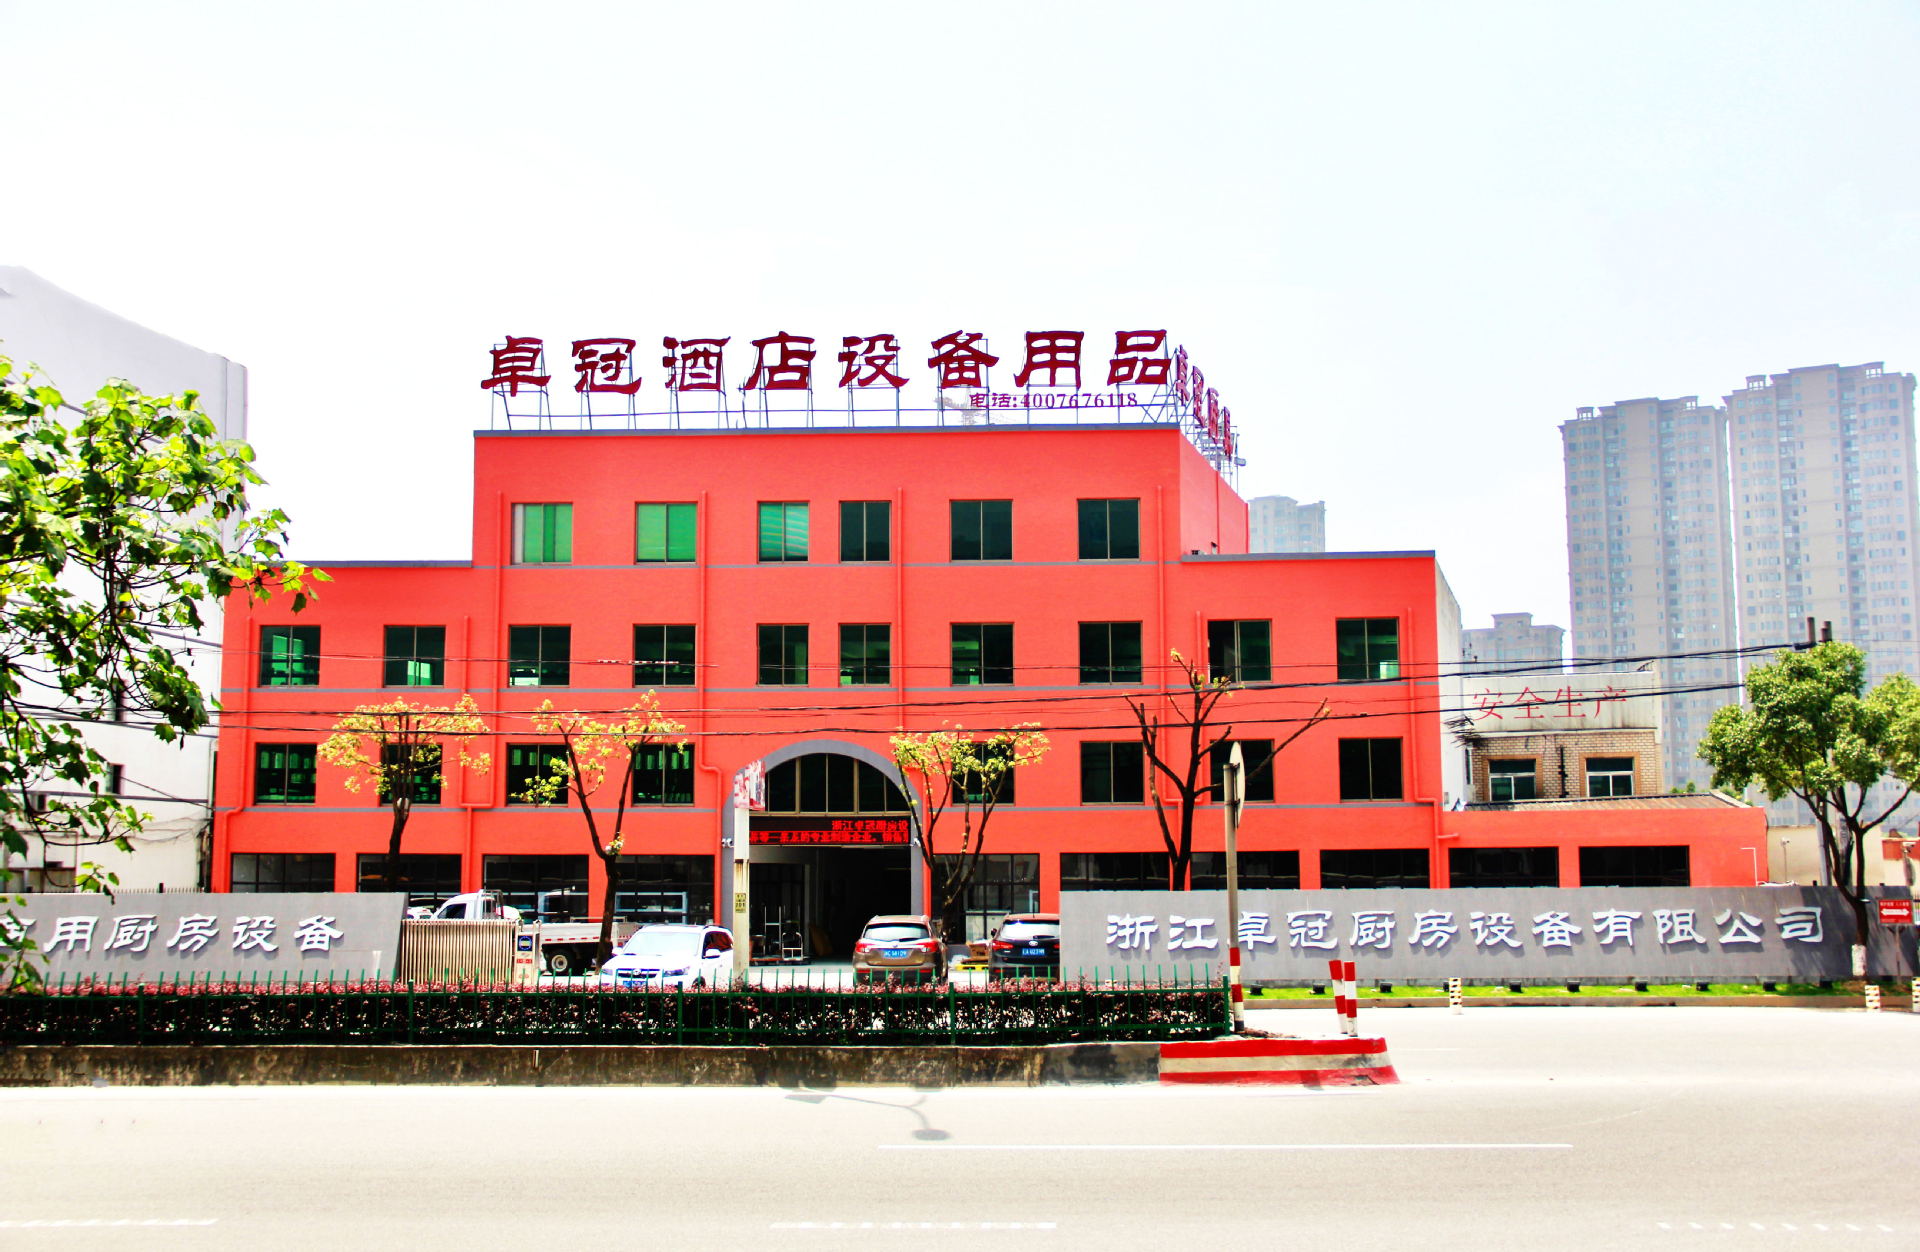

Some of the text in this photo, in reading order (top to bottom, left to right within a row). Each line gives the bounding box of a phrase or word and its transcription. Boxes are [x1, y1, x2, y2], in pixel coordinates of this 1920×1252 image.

[481, 330, 1171, 396] 卓冠酒店设备用品
[1472, 685, 1627, 721] 安全生产
[1106, 906, 1823, 951] 浙江卓冠厨房设备有限公司
